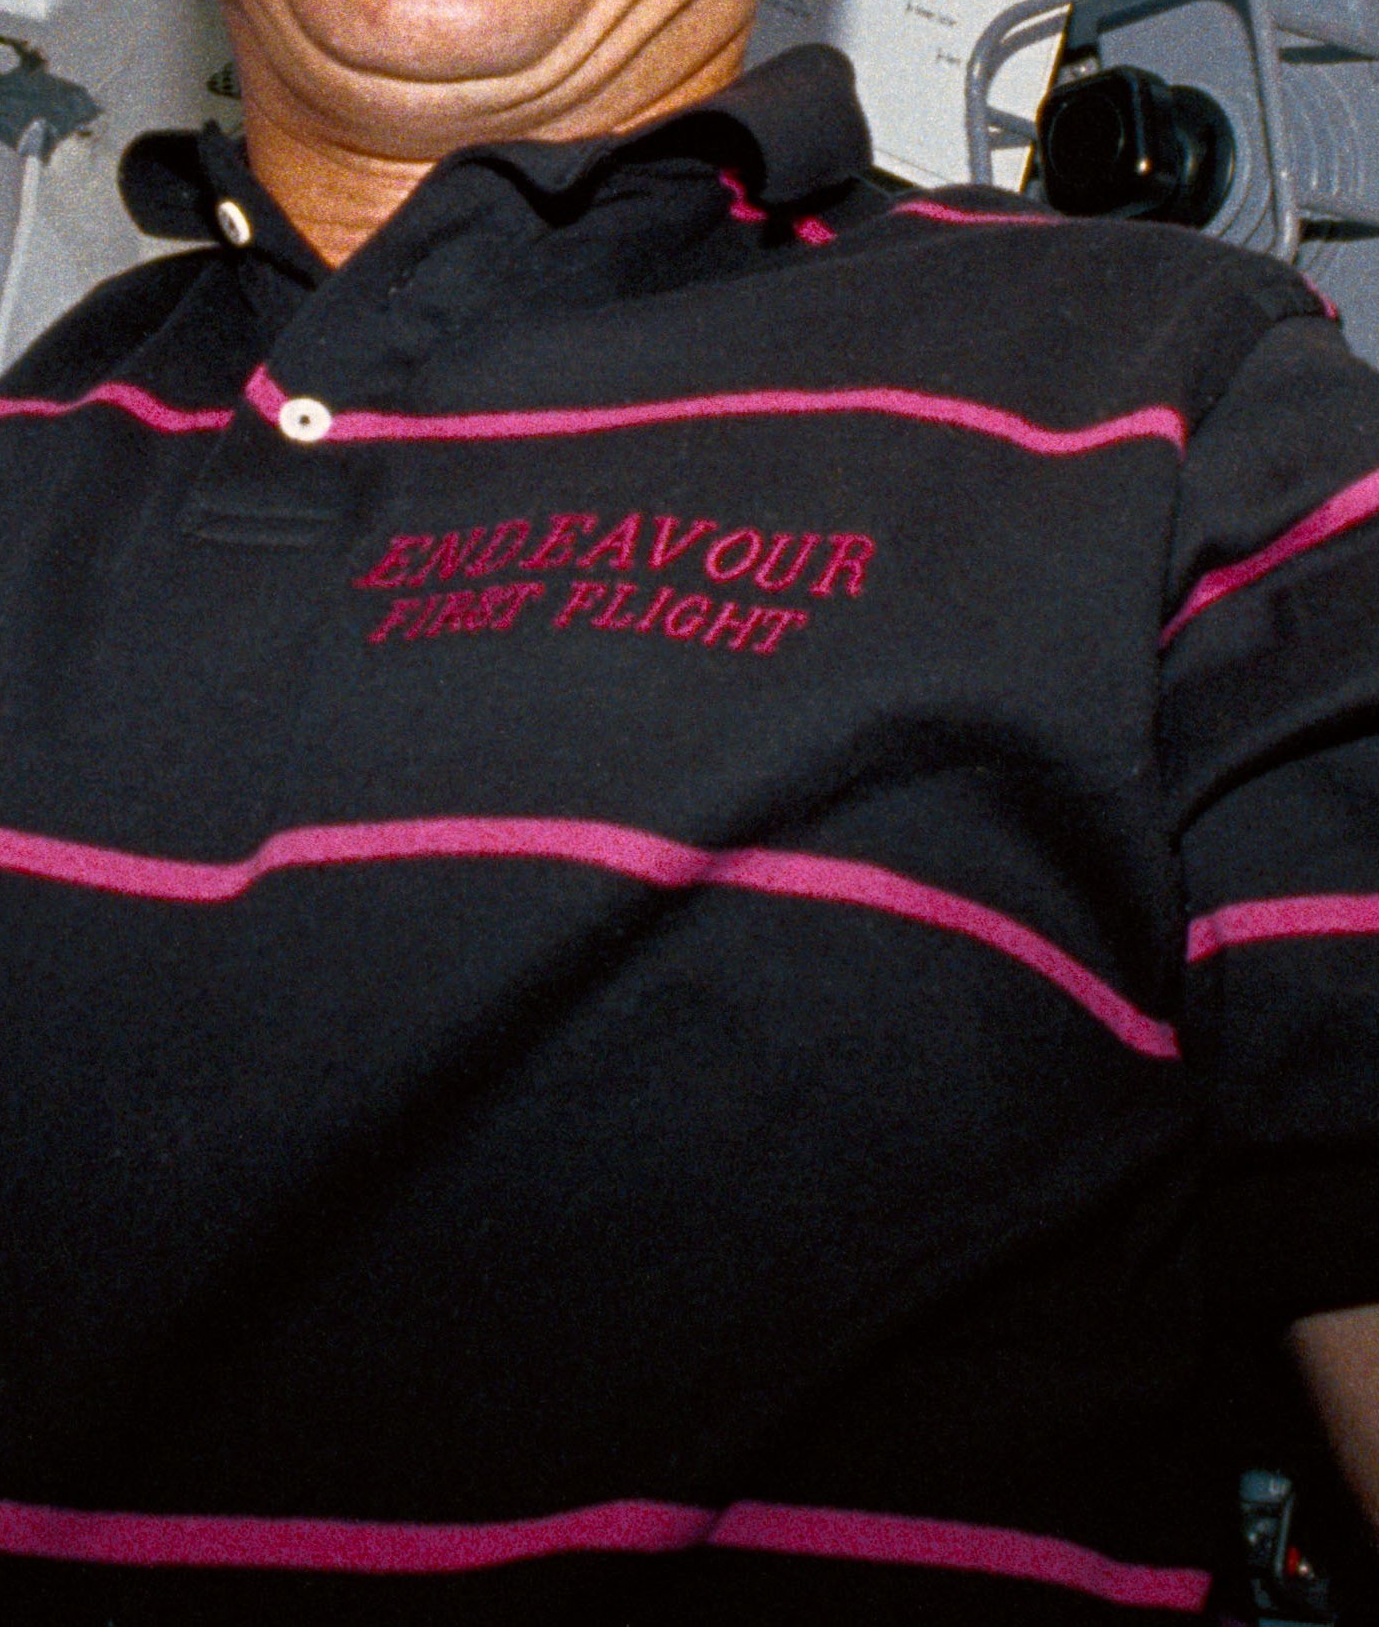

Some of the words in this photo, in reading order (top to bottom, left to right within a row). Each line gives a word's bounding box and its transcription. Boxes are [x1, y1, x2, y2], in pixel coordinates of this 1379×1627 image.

[355, 511, 877, 597] ENDEAVOUR
[367, 581, 546, 644] FIRST
[553, 579, 809, 654] FLIGHT
